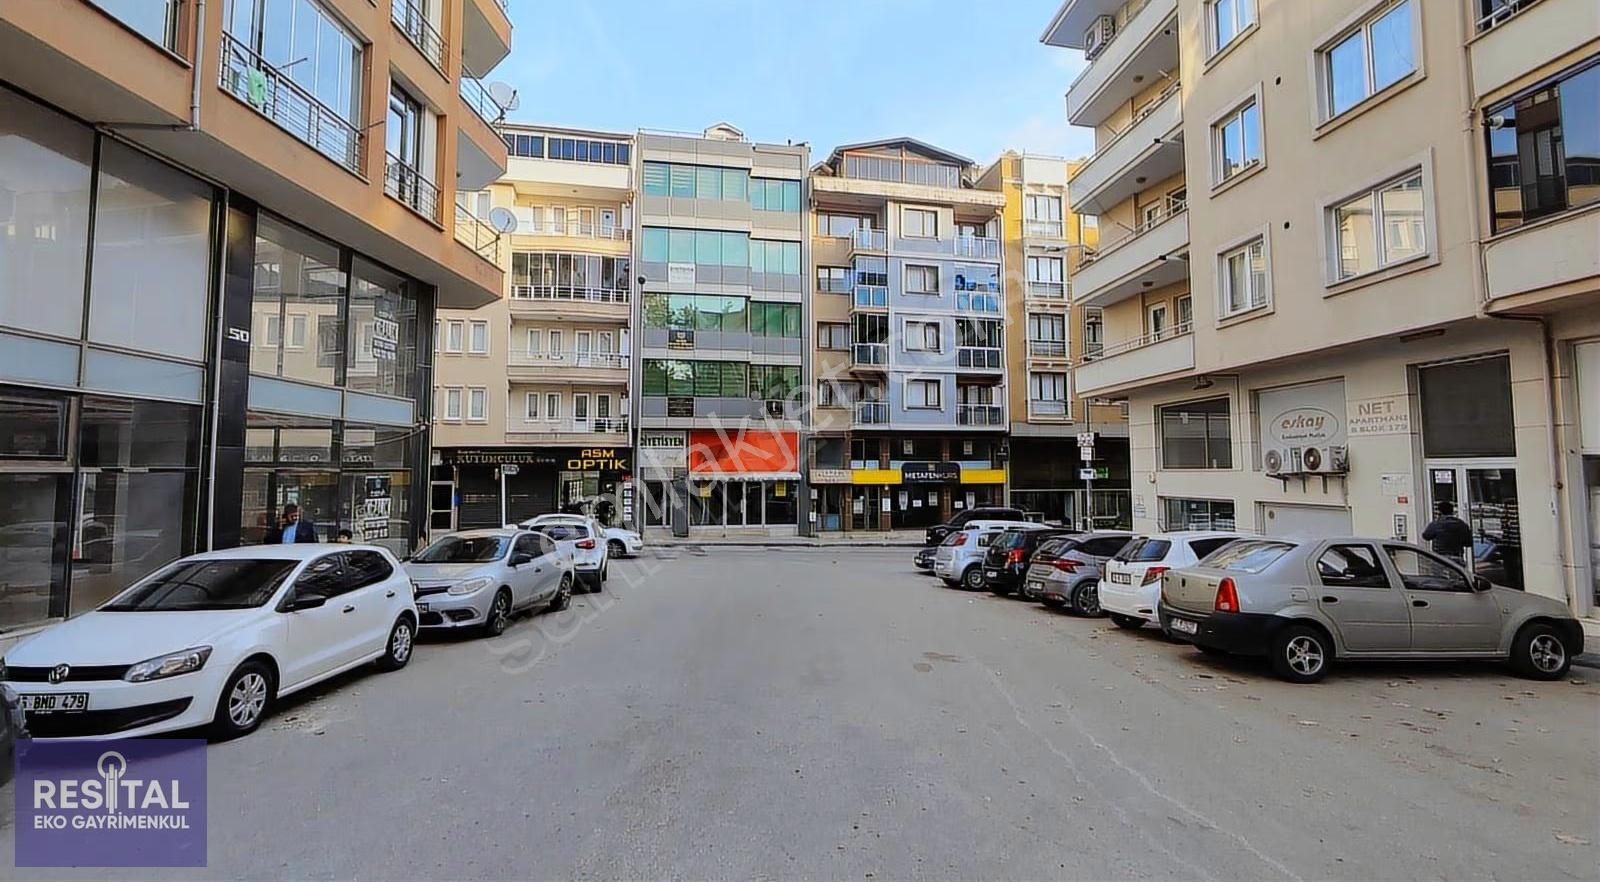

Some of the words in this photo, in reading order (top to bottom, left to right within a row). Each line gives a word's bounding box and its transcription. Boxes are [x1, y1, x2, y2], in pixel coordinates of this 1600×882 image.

[1359, 400, 1395, 415] NET
[581, 448, 615, 458] ASM
[62, 695, 84, 708] 479
